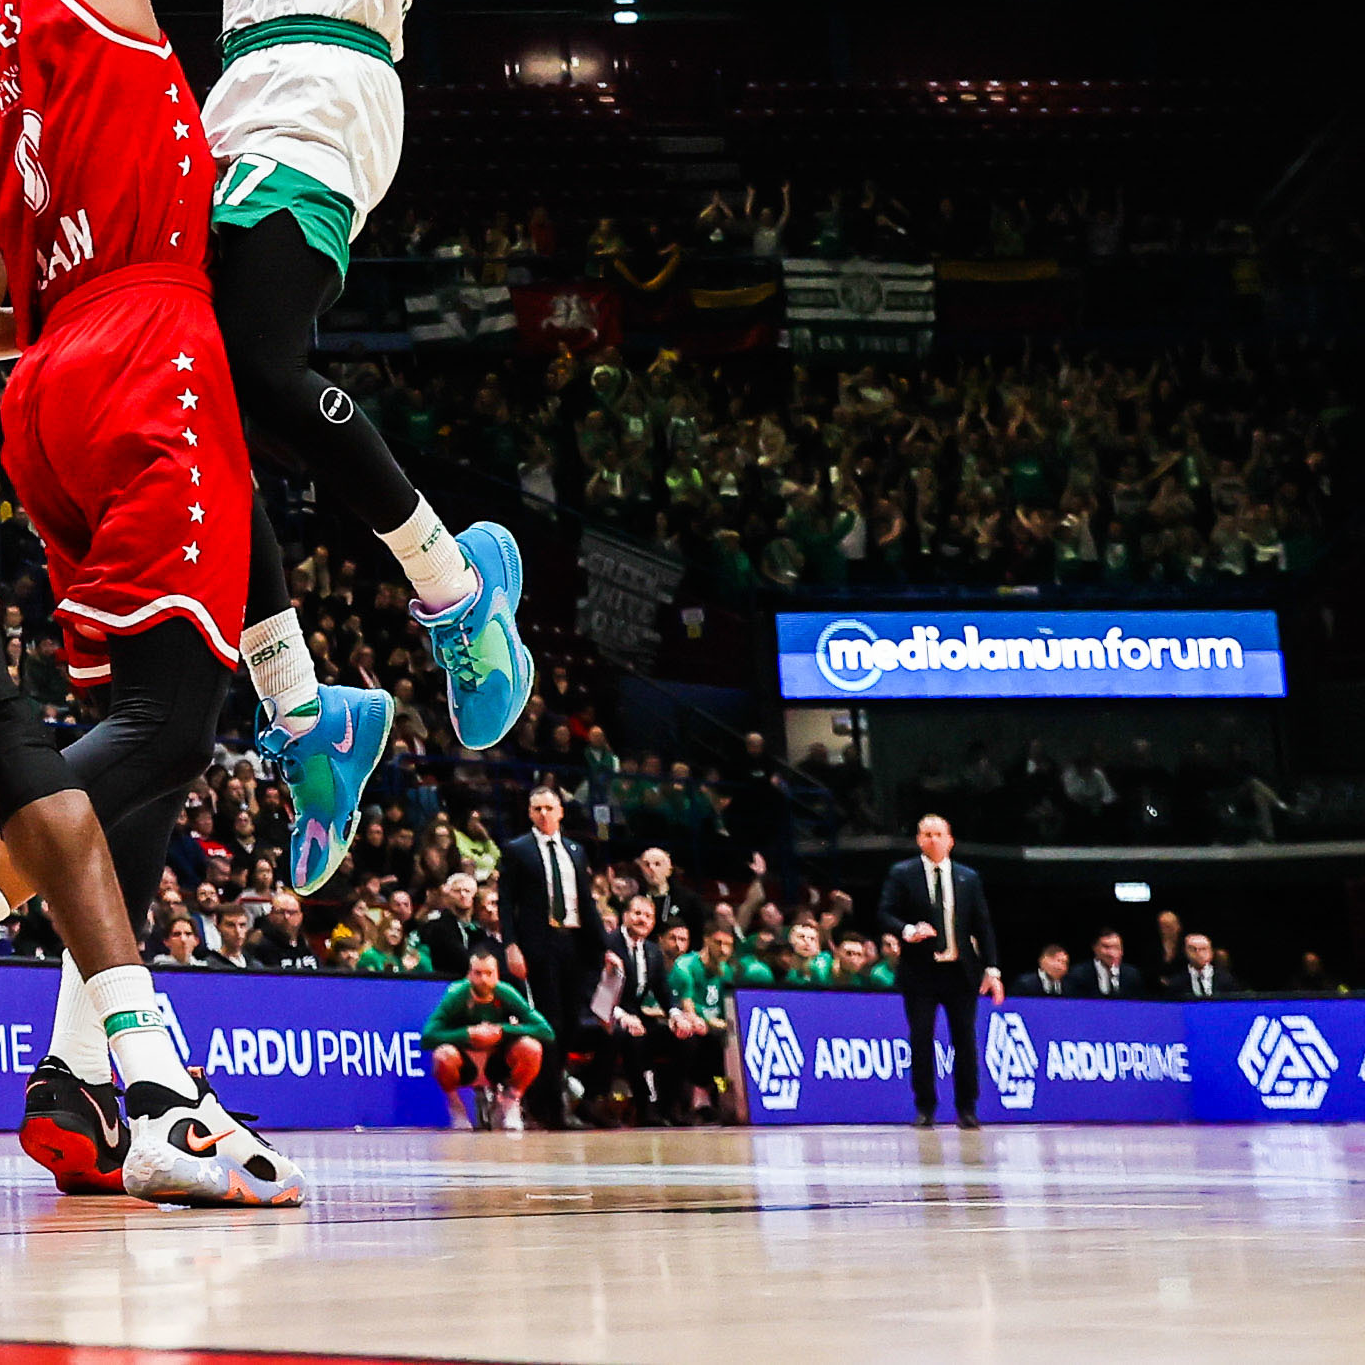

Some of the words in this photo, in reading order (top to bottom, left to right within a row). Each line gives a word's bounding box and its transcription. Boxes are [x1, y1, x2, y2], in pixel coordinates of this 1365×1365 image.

[250, 639, 290, 667] GSA
[828, 624, 1245, 671] mediolanumforum
[205, 1027, 426, 1078] ARDUPRIME
[1046, 1039, 1193, 1083] ARDUPRIME
